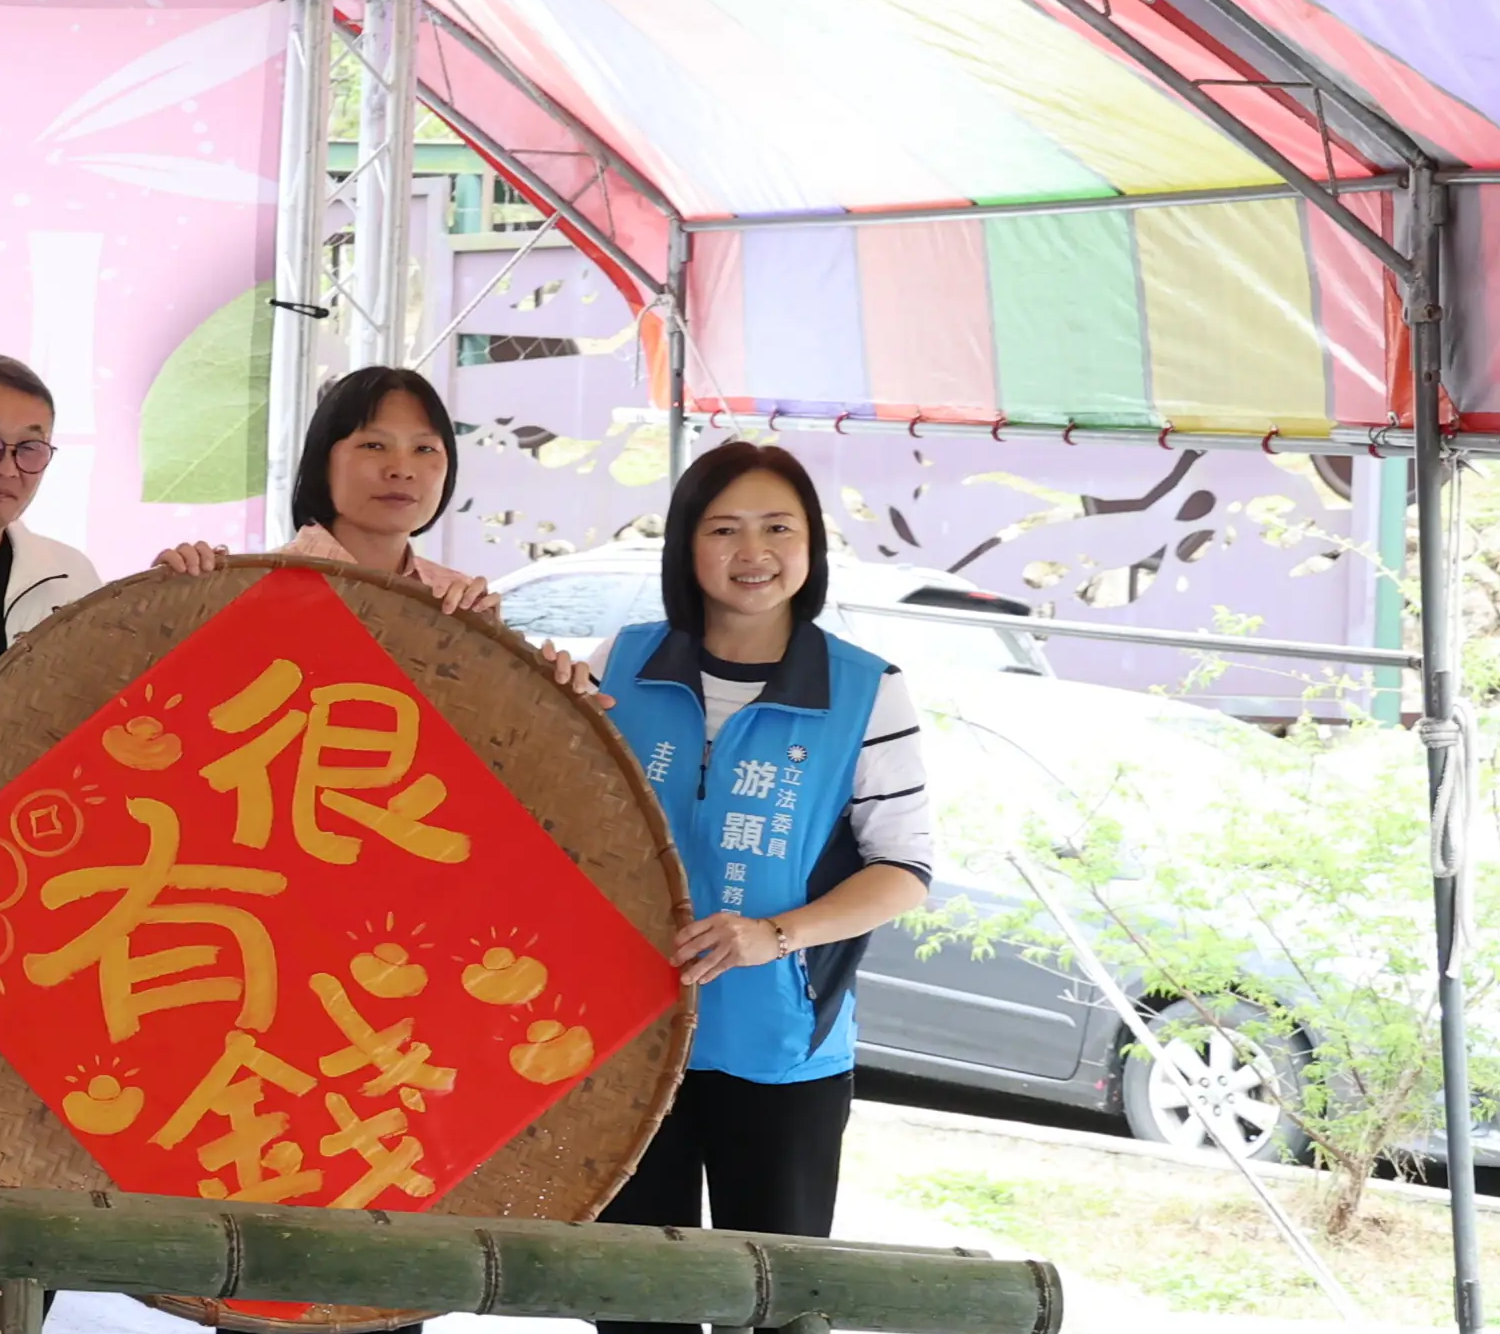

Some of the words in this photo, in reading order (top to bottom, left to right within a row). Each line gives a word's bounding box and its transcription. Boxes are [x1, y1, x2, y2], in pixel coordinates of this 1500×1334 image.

[647, 741, 677, 783] 主任
[719, 760, 778, 916] 游顥服務
[765, 765, 803, 860] 立法委員
